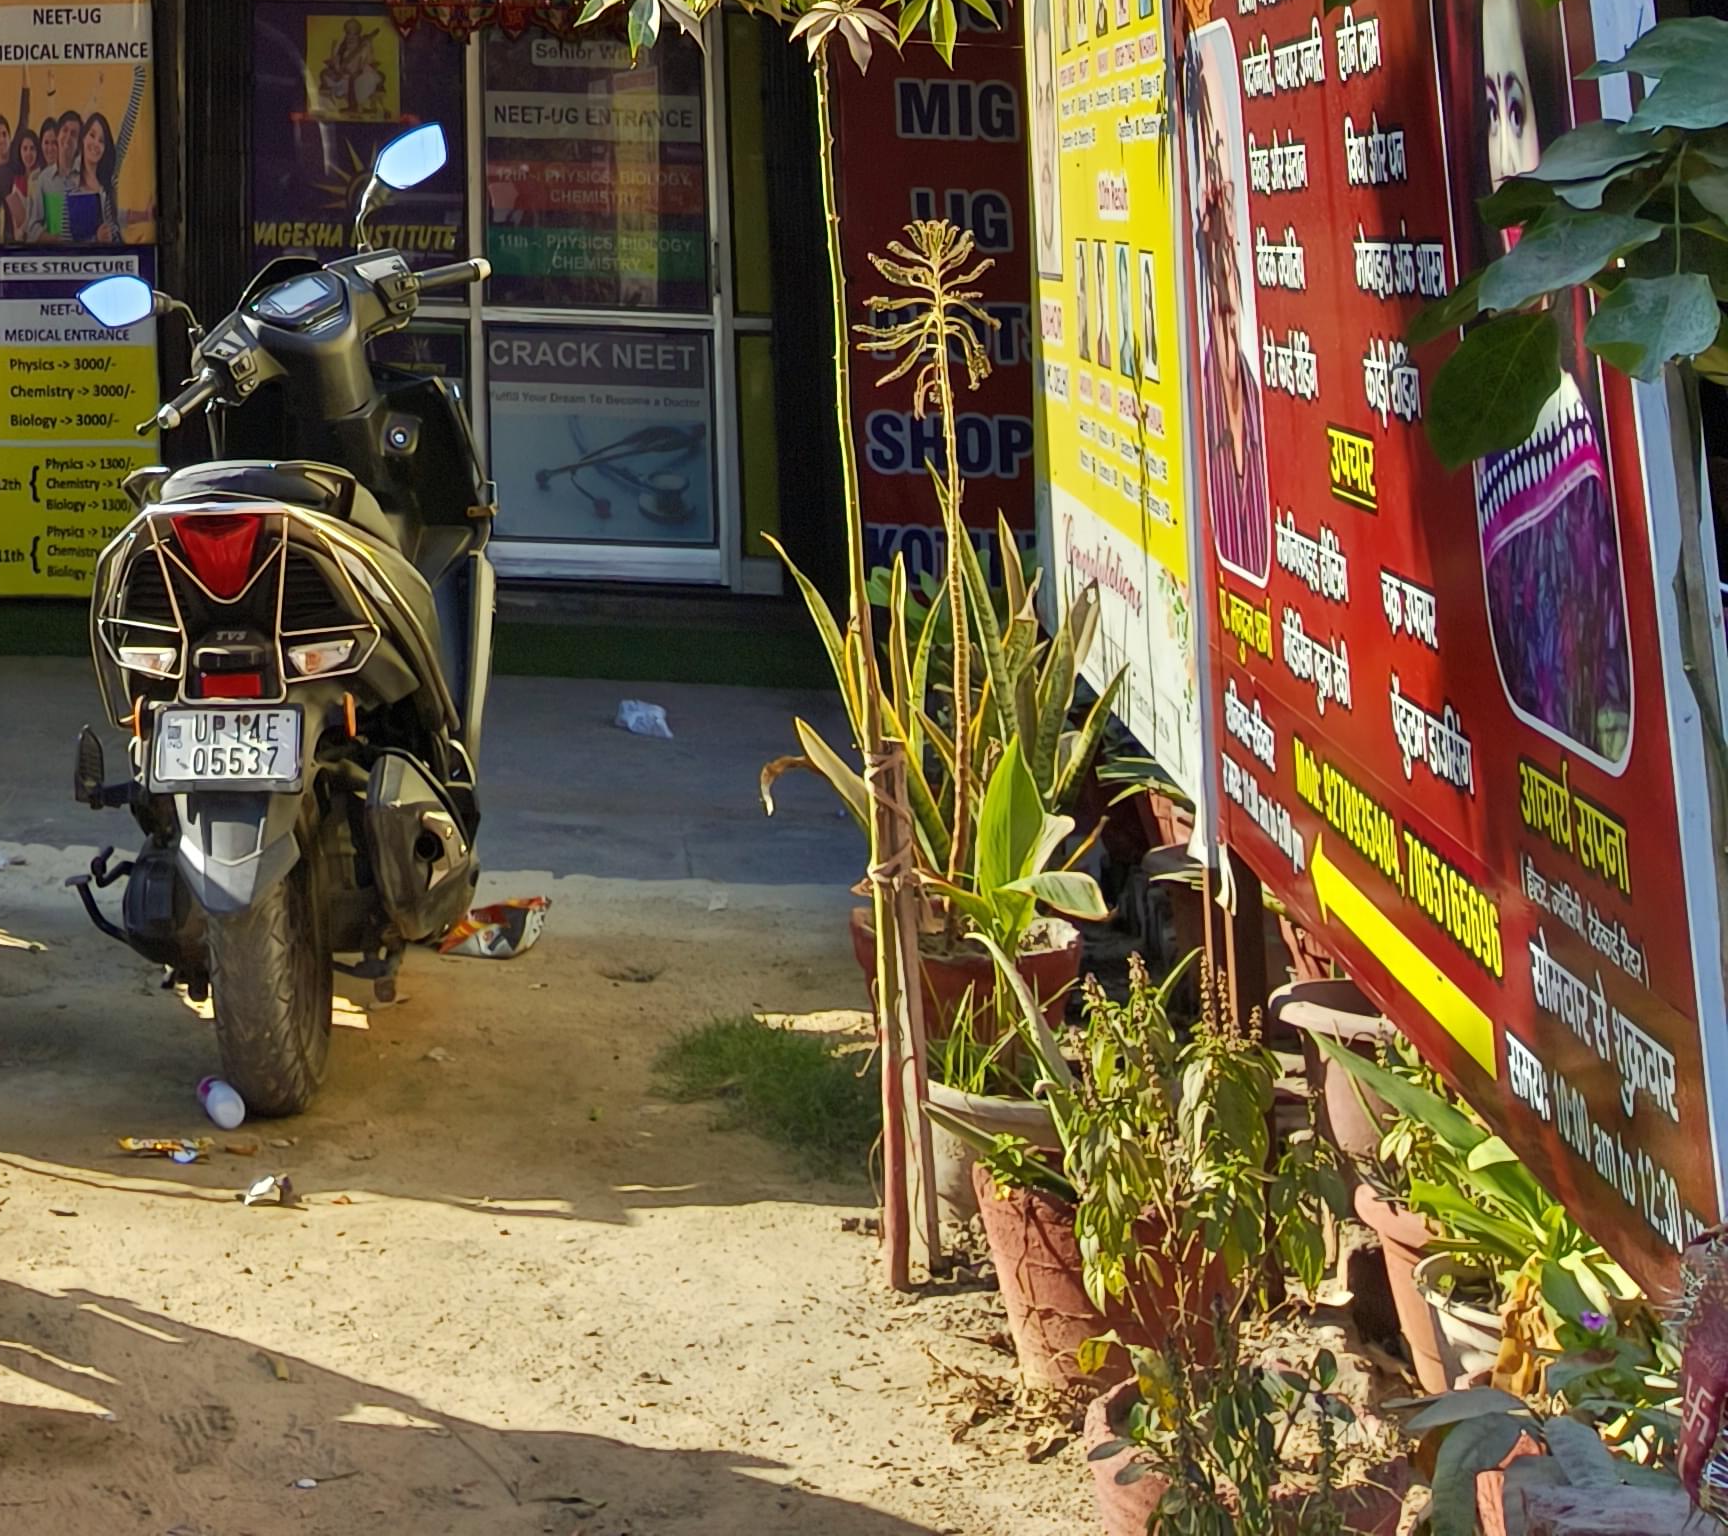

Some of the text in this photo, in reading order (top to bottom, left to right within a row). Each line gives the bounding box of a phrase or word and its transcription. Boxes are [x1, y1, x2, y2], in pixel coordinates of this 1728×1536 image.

[33, 8, 101, 25] NEET-UG
[64, 42, 148, 60] ENTRANCE
[536, 43, 593, 60] Senior
[494, 106, 693, 128] NEET-UG ENTRANCE
[899, 82, 1015, 137] MIG
[550, 190, 639, 204] CHEMISTRY
[253, 221, 344, 248] VAGESHA
[3, 260, 134, 275] FEES STRUCTURE
[552, 256, 641, 271] CHEMISTRY
[40, 304, 88, 317] NEET-U
[5, 328, 130, 342] MEDICAL ENTRANCE
[489, 340, 697, 371] CRACK NEET
[9, 357, 117, 373] Physics 3000/-
[10, 384, 136, 401] Chemistry 3000/-
[10, 413, 120, 429] Biology 3000/-
[871, 414, 1032, 473] SHOP
[45, 457, 84, 471] Physics
[1327, 427, 1376, 498] उपचार
[46, 478, 100, 493] Chemistry
[46, 499, 85, 514] Biology
[47, 526, 86, 541] Physics
[47, 566, 87, 581] Biology
[216, 631, 248, 641] TVS
[192, 746, 279, 776] Q5537
[1518, 754, 1632, 896] आचार्य सपना
[1292, 735, 1322, 815] Mob:
[1403, 829, 1504, 980] 7065165696
[1529, 927, 1682, 1120] सोमवार से शुक्रवार
[1552, 1068, 1593, 1161] 10:00
[1591, 1122, 1619, 1185] am
[1618, 1136, 1637, 1208] to
[1635, 1152, 1685, 1255] 12:30
